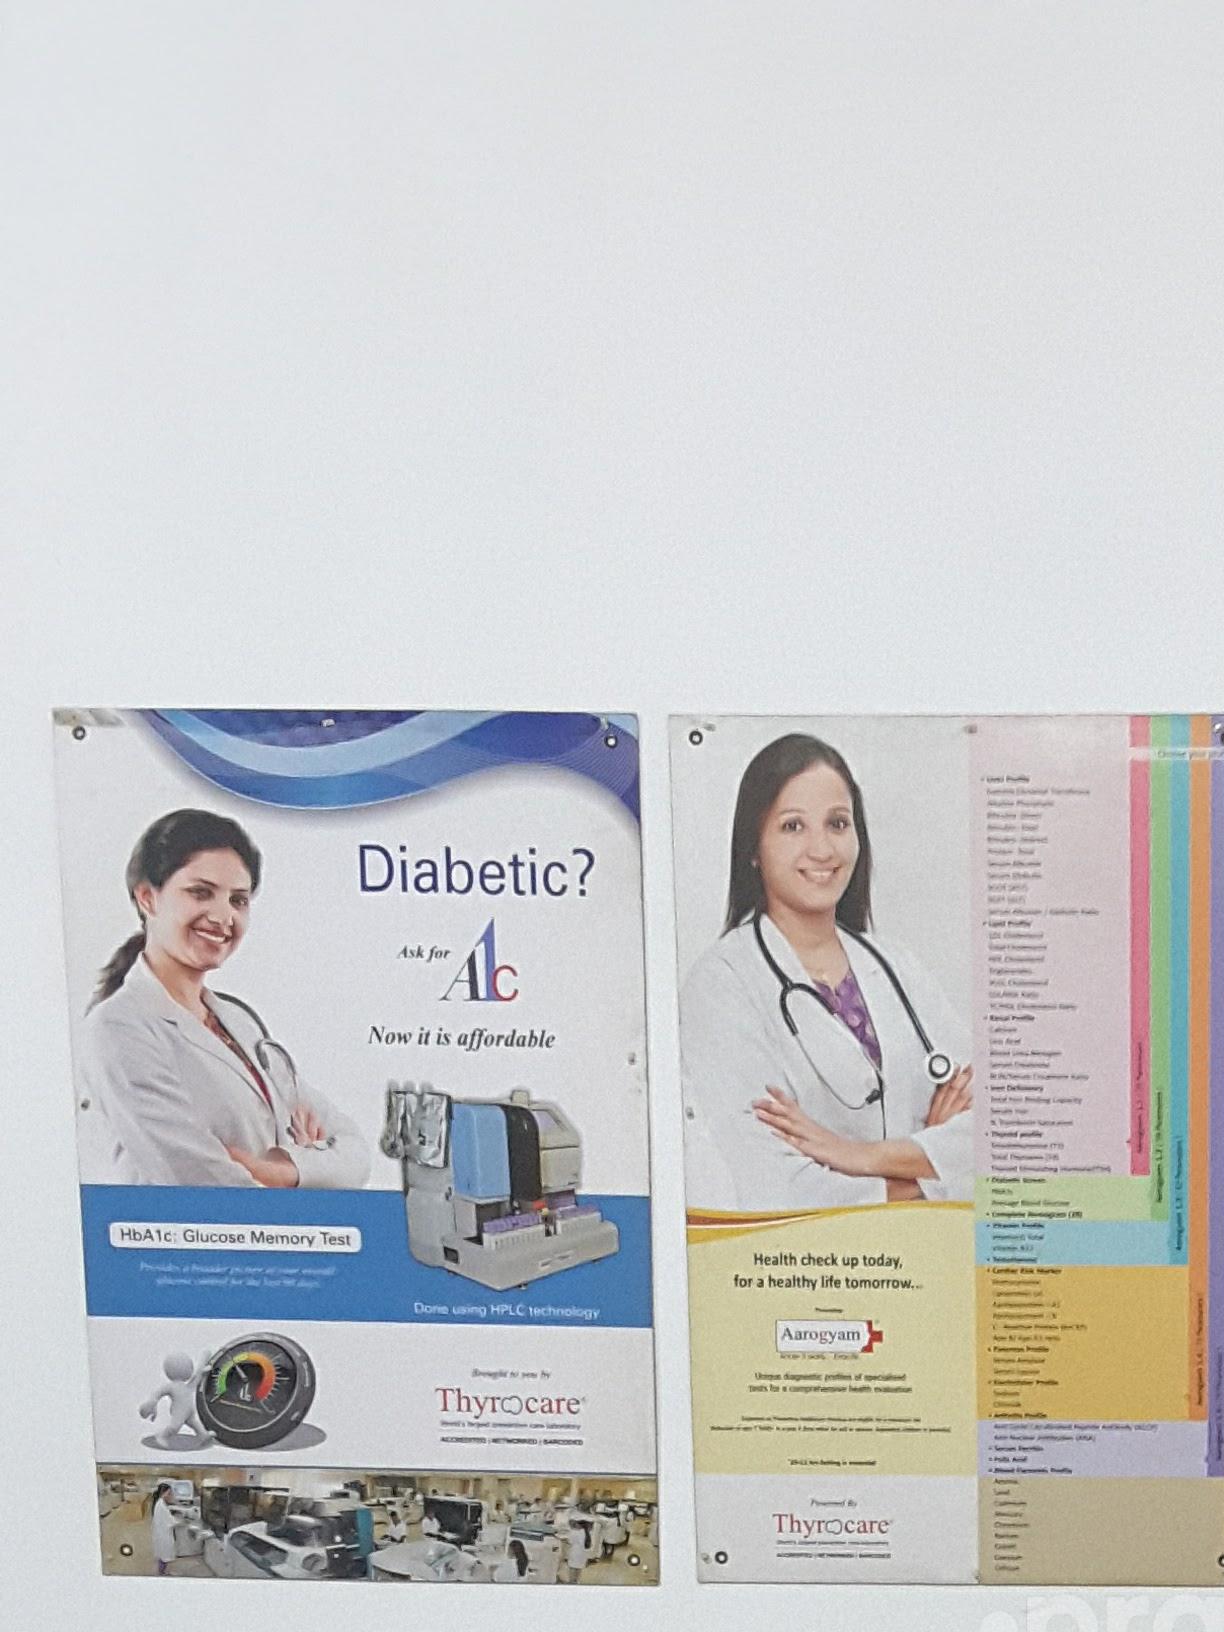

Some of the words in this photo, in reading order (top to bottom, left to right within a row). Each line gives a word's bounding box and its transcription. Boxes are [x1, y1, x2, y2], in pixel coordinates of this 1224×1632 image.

[358, 844, 596, 897] Diabetic?
[397, 945, 424, 960] Ask
[426, 946, 451, 963] for
[368, 1026, 412, 1045] Now
[418, 1026, 430, 1045] it
[436, 1026, 450, 1045] is
[457, 1028, 556, 1051] affordable
[120, 1228, 176, 1243] HbA1c:
[183, 1228, 246, 1244] Glucose
[250, 1230, 315, 1248] Memory
[320, 1231, 352, 1246] Test
[753, 1252, 797, 1267] Health
[800, 1253, 838, 1267] check
[842, 1256, 859, 1270] up
[862, 1253, 903, 1270] today,
[734, 1274, 753, 1289] for
[756, 1278, 765, 1289] a
[768, 1275, 817, 1291] healthy
[821, 1275, 841, 1289] life
[845, 1276, 923, 1290] tomorrow...
[414, 1302, 449, 1316] Done
[452, 1303, 487, 1319] using
[490, 1303, 525, 1317] HPLC
[529, 1306, 600, 1321] technology
[780, 1326, 861, 1345] Aarogyam
[435, 1386, 581, 1419] Thyrocare
[772, 1513, 889, 1538] Thyrocare
